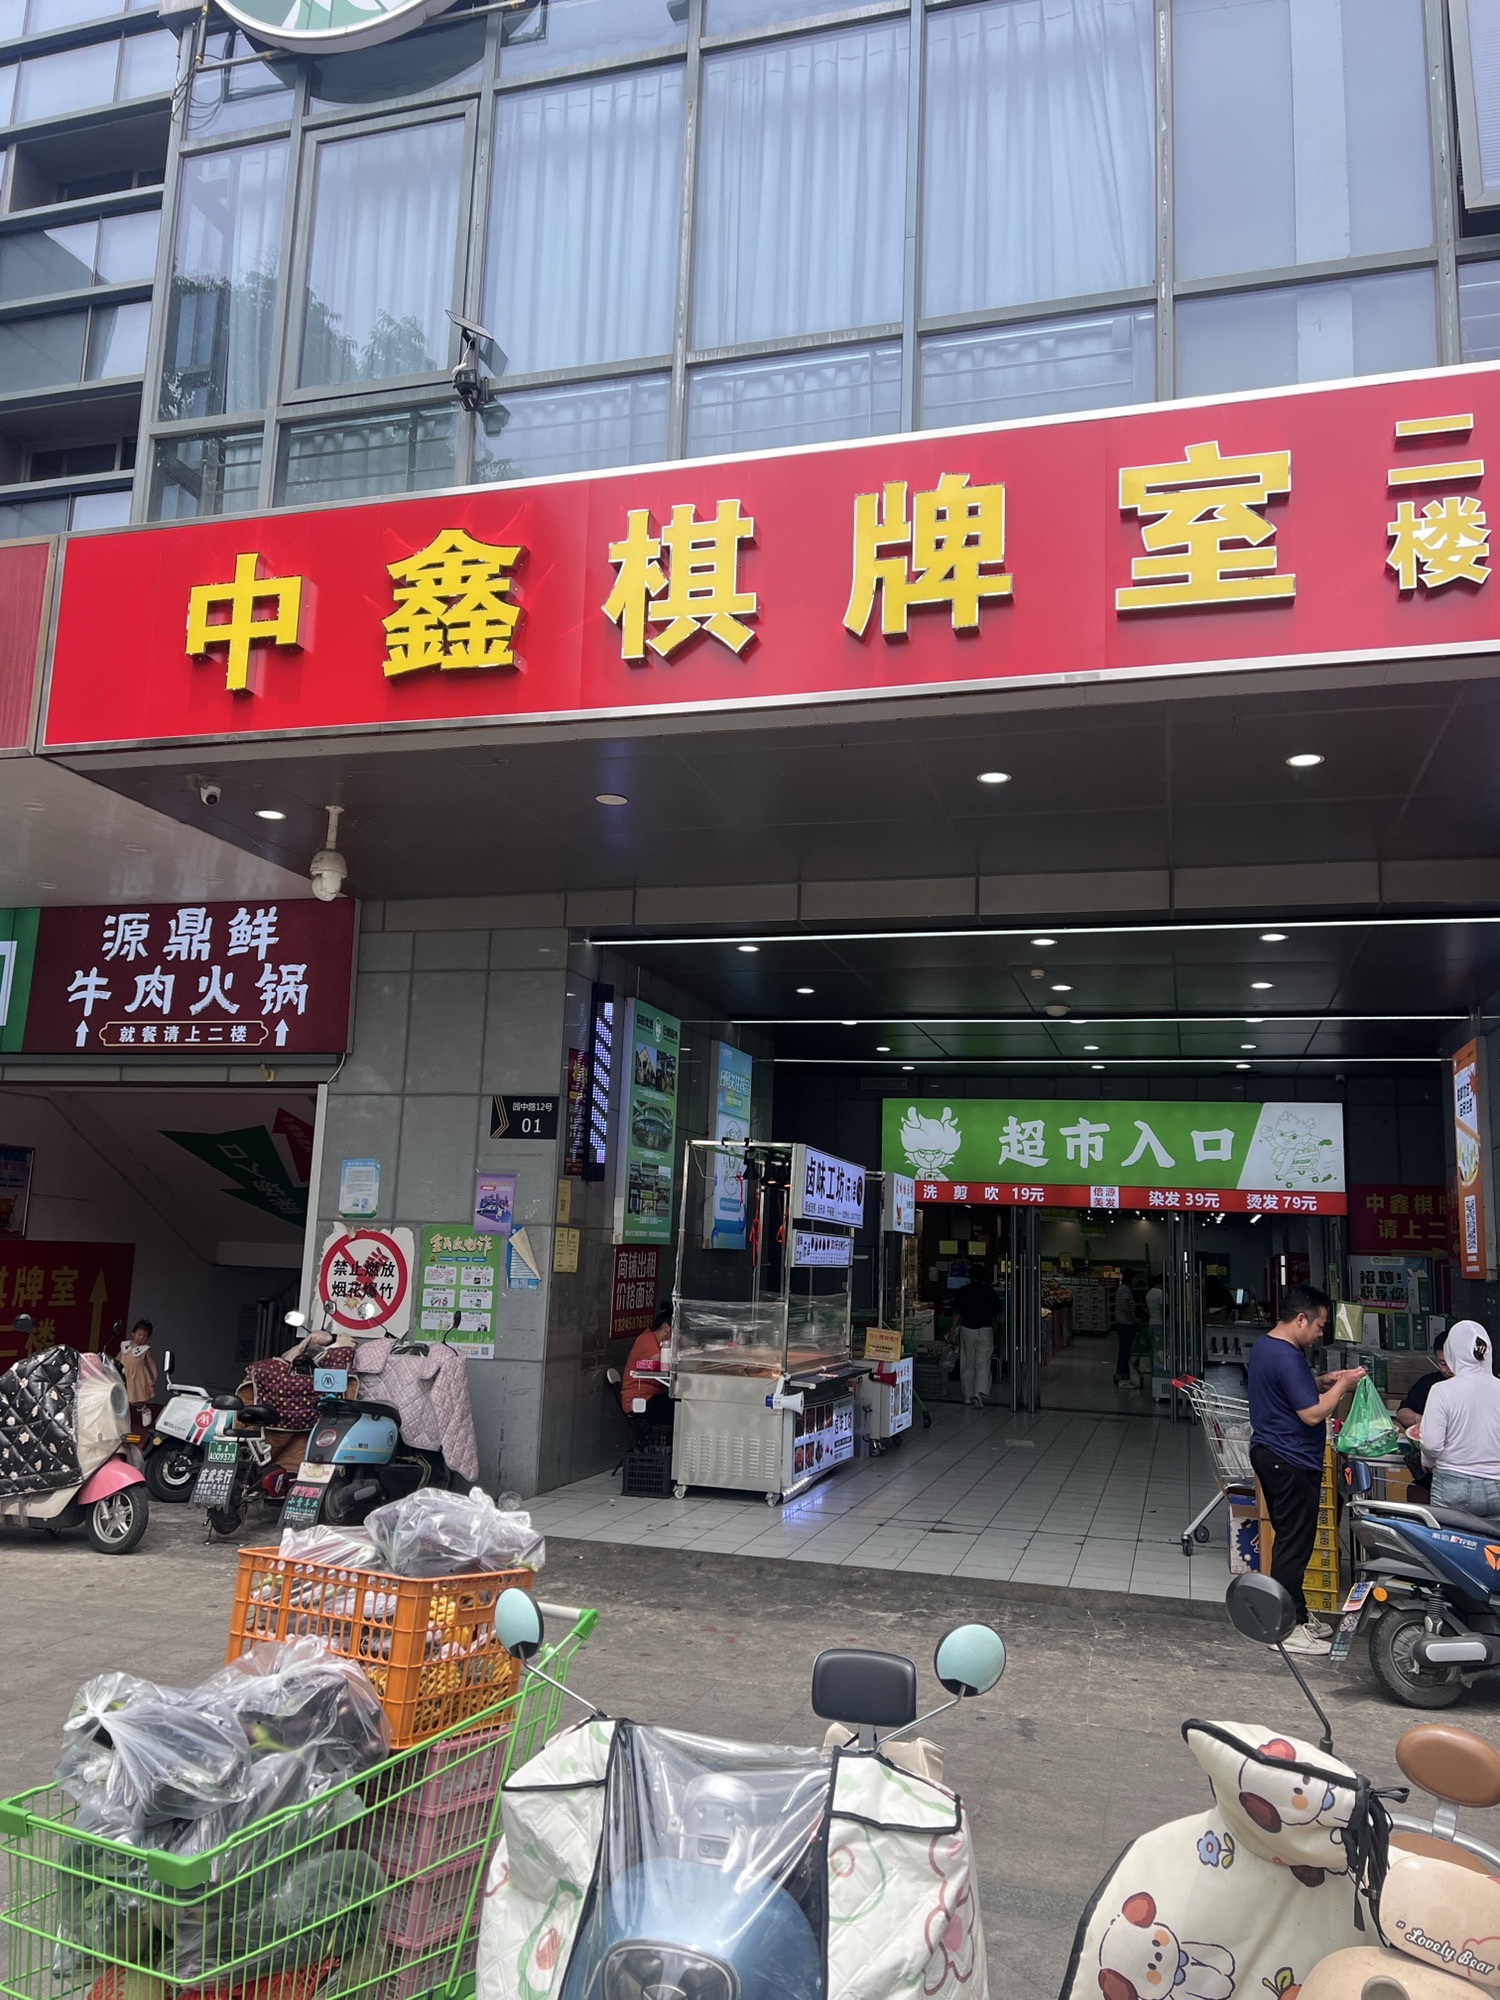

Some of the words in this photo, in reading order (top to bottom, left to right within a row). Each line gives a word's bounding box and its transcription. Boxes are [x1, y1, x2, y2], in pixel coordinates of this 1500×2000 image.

[186, 440, 1298, 692] 中鑫棋牌室
[1386, 412, 1492, 592] 二楼
[101, 906, 279, 962] 源鼎鲜
[67, 963, 309, 1017] 牛肉火锅
[119, 1025, 248, 1044] 就餐请上二楼
[512, 1102, 553, 1112] 园中路12号
[521, 1117, 542, 1133] 01
[998, 1115, 1235, 1169] 超市入口
[805, 1156, 846, 1204] 卤味工坊
[1011, 1187, 1045, 1203] 19元
[1093, 1197, 1116, 1208] 美发
[1149, 1190, 1181, 1208] 染发
[1185, 1192, 1220, 1209] 39元
[1246, 1193, 1279, 1211] 烫发
[1283, 1195, 1318, 1211] 79元
[333, 1259, 395, 1278] 禁止燃放
[617, 1251, 657, 1279] 商铺出租
[331, 1280, 394, 1300] 烟花爆竹
[616, 1281, 656, 1312] 价格面谈
[1360, 1285, 1409, 1300] 职等你
[1405, 1927, 1456, 1963] Lovely
[1456, 1948, 1495, 1976] Bear
